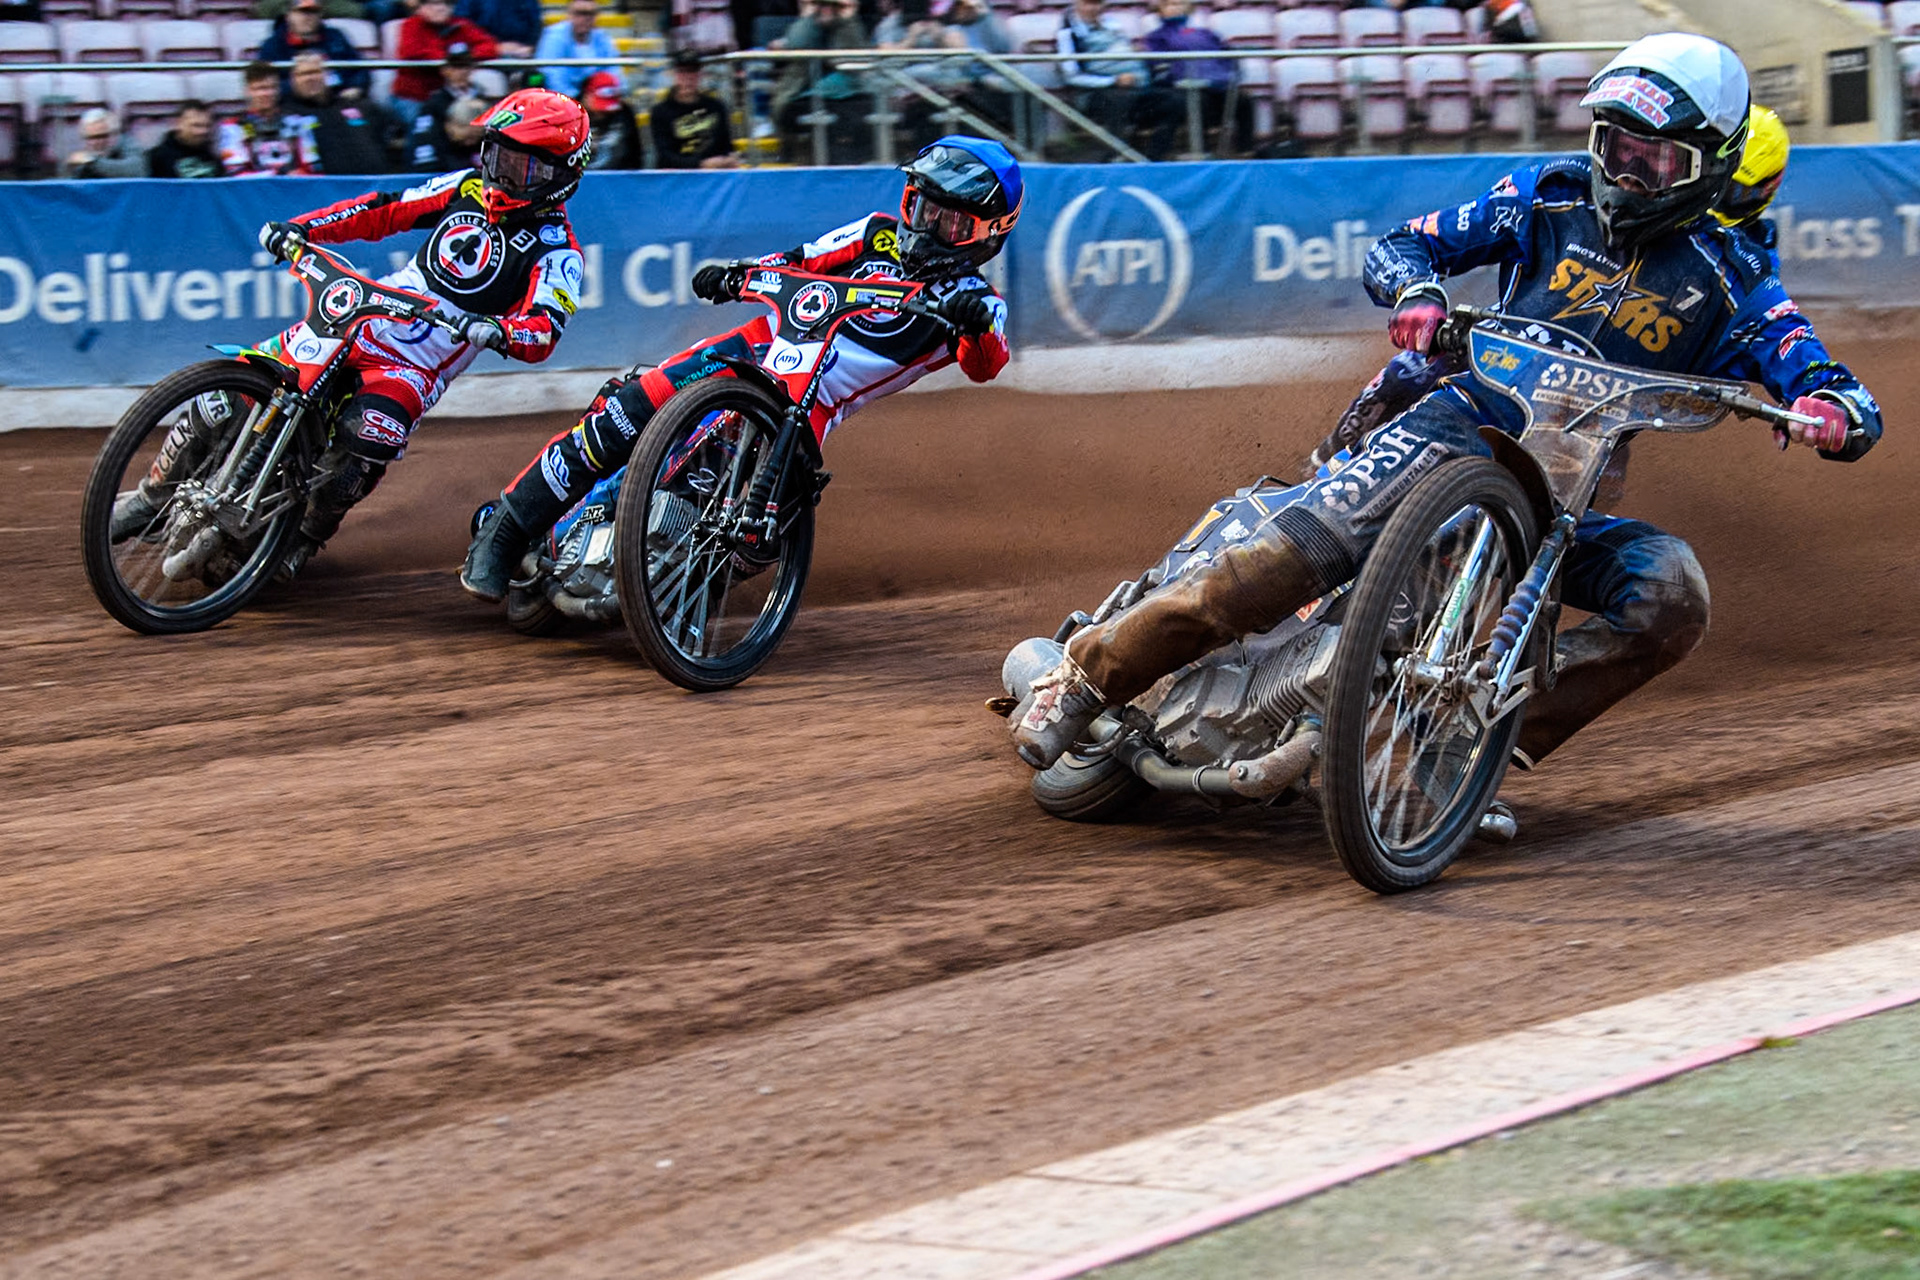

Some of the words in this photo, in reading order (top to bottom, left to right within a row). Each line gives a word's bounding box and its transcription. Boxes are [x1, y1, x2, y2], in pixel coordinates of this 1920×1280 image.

[1632, 78, 1671, 107] MAN
[1635, 96, 1667, 124] VAN
[449, 215, 480, 228] BELLE
[489, 240, 501, 268] ACES
[1758, 205, 1883, 261] lass
[866, 263, 897, 276] BELLE
[1070, 239, 1166, 287] ATPI
[1566, 242, 1596, 259] KING'S
[1595, 253, 1621, 271] LYNN
[1676, 285, 1705, 312] 7
[778, 354, 797, 365] ATPI
[1345, 425, 1428, 490] PSH
